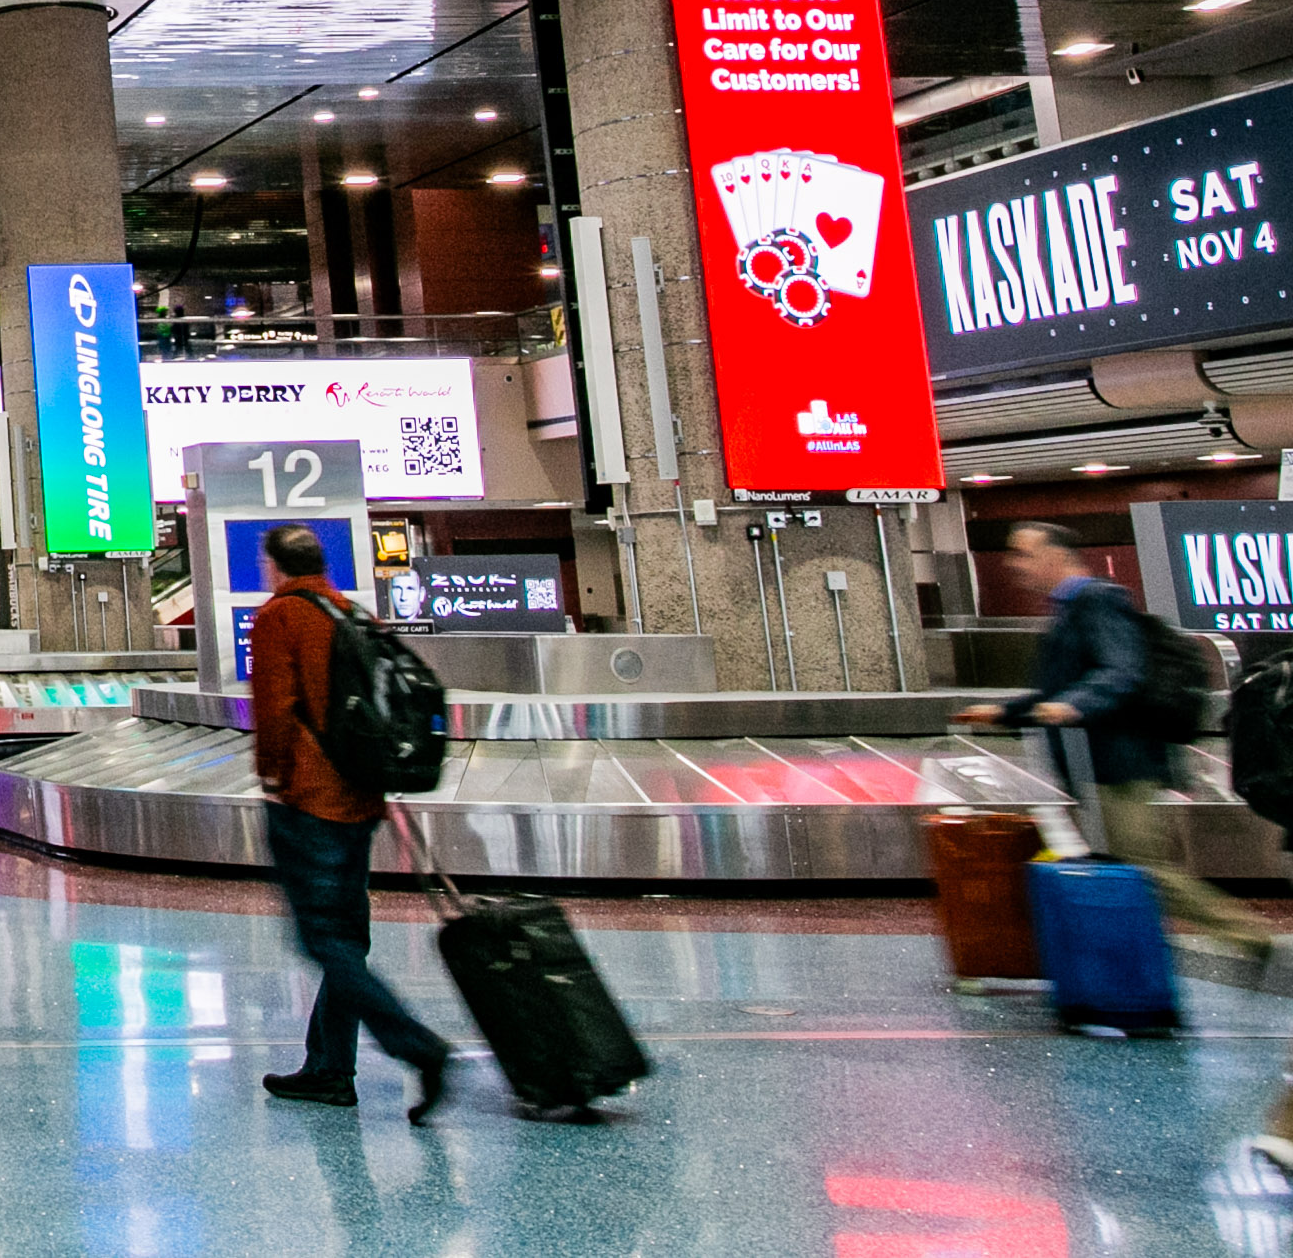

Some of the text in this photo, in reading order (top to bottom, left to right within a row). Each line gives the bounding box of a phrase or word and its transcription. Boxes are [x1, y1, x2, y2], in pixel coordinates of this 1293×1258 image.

[703, 8, 854, 31] Limit to Our
[703, 37, 861, 61] Care for Our
[711, 68, 860, 91] Customers!
[720, 159, 812, 183] 10 J Q K A
[1169, 161, 1259, 223] SAT
[934, 173, 1139, 335] KASKADE
[1176, 221, 1277, 270] NOV 4
[145, 384, 306, 404] KATY PERRY
[407, 385, 453, 397] World
[833, 423, 853, 435] All
[836, 413, 858, 423] LAS
[75, 331, 112, 541] LINGLONG TIRE
[248, 448, 326, 508] 12
[747, 491, 812, 501] NanoLumens
[856, 491, 928, 500] LAMAR
[1215, 613, 1262, 630] SAT
